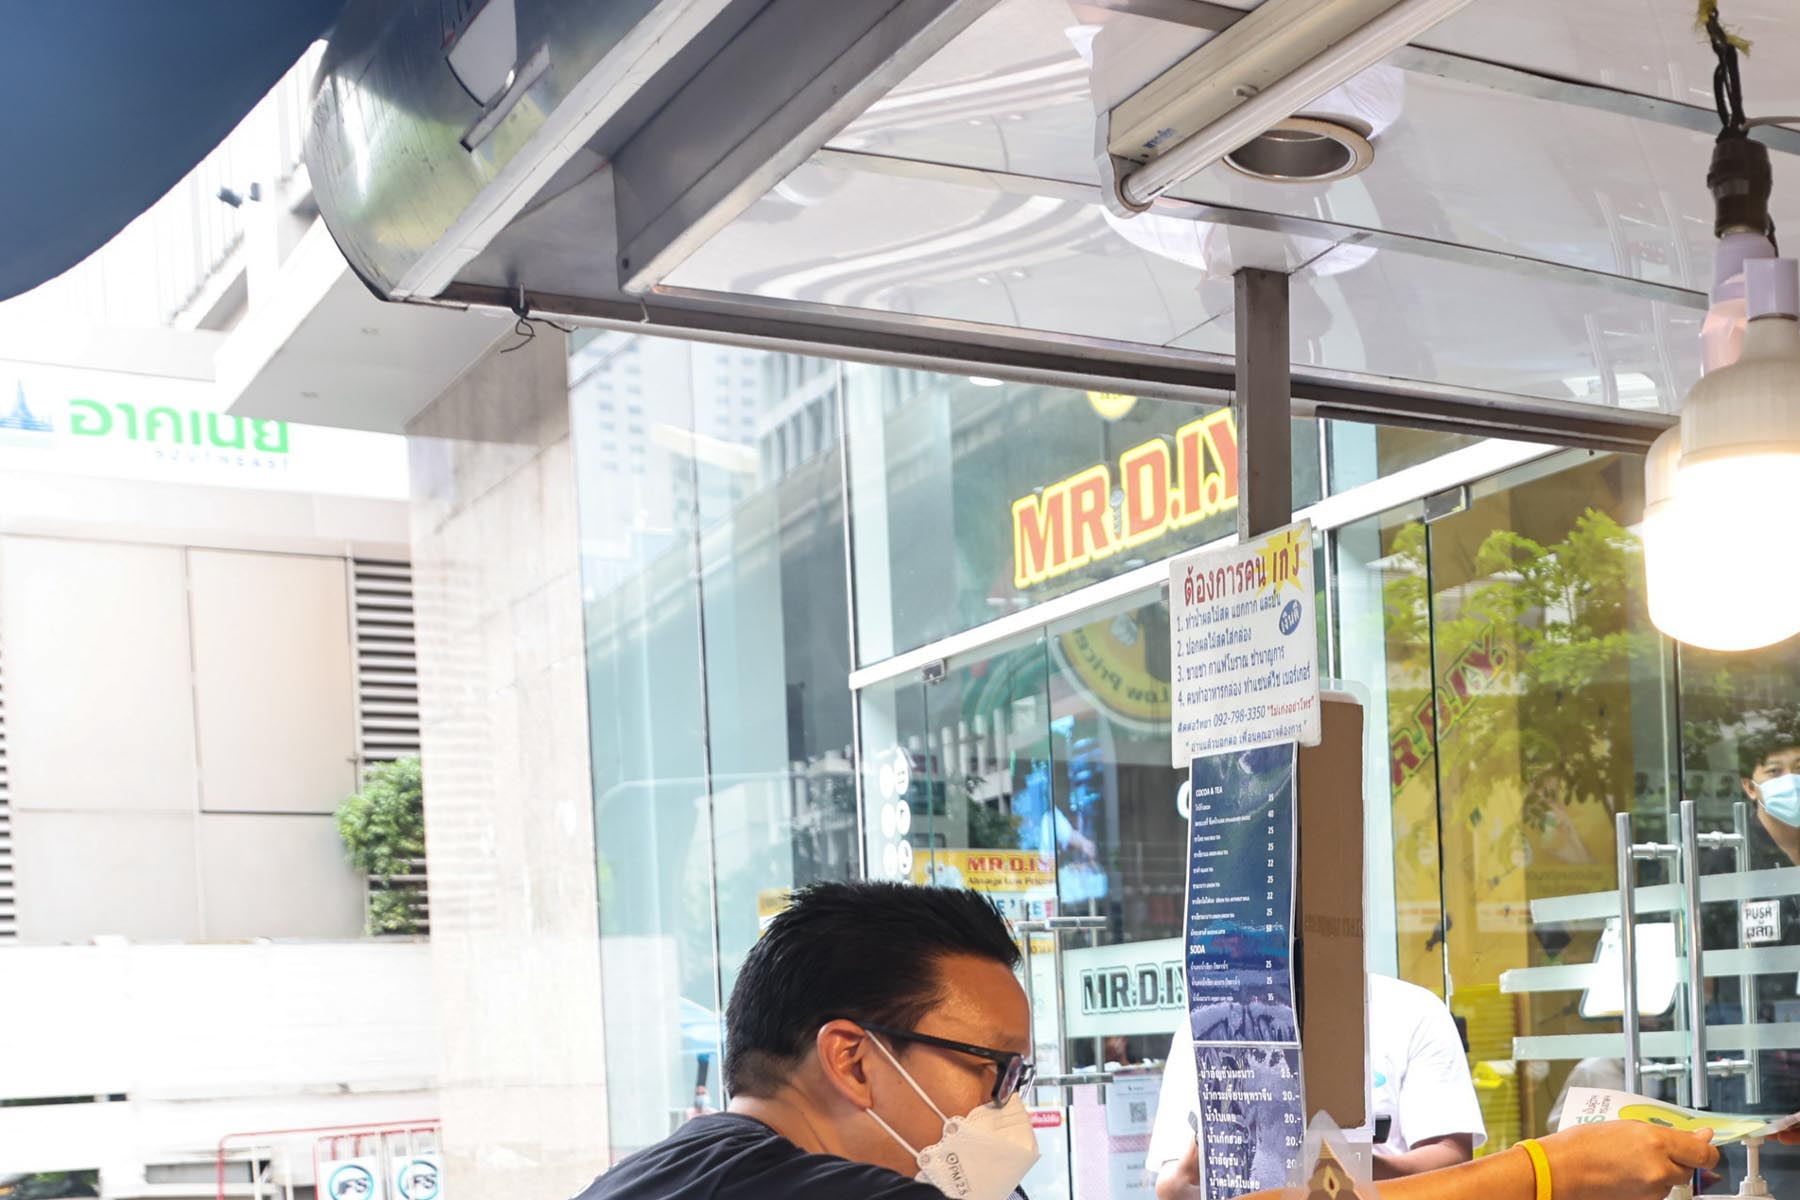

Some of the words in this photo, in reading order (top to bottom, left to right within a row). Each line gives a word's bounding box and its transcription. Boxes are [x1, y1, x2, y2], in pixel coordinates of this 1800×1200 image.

[1184, 555, 1267, 607] ต้องการคน
[1272, 531, 1301, 583] เก่ง
[1213, 704, 1266, 729] 092-798-3350
[1745, 906, 1773, 920] PUSH
[1190, 944, 1206, 955] SODA
